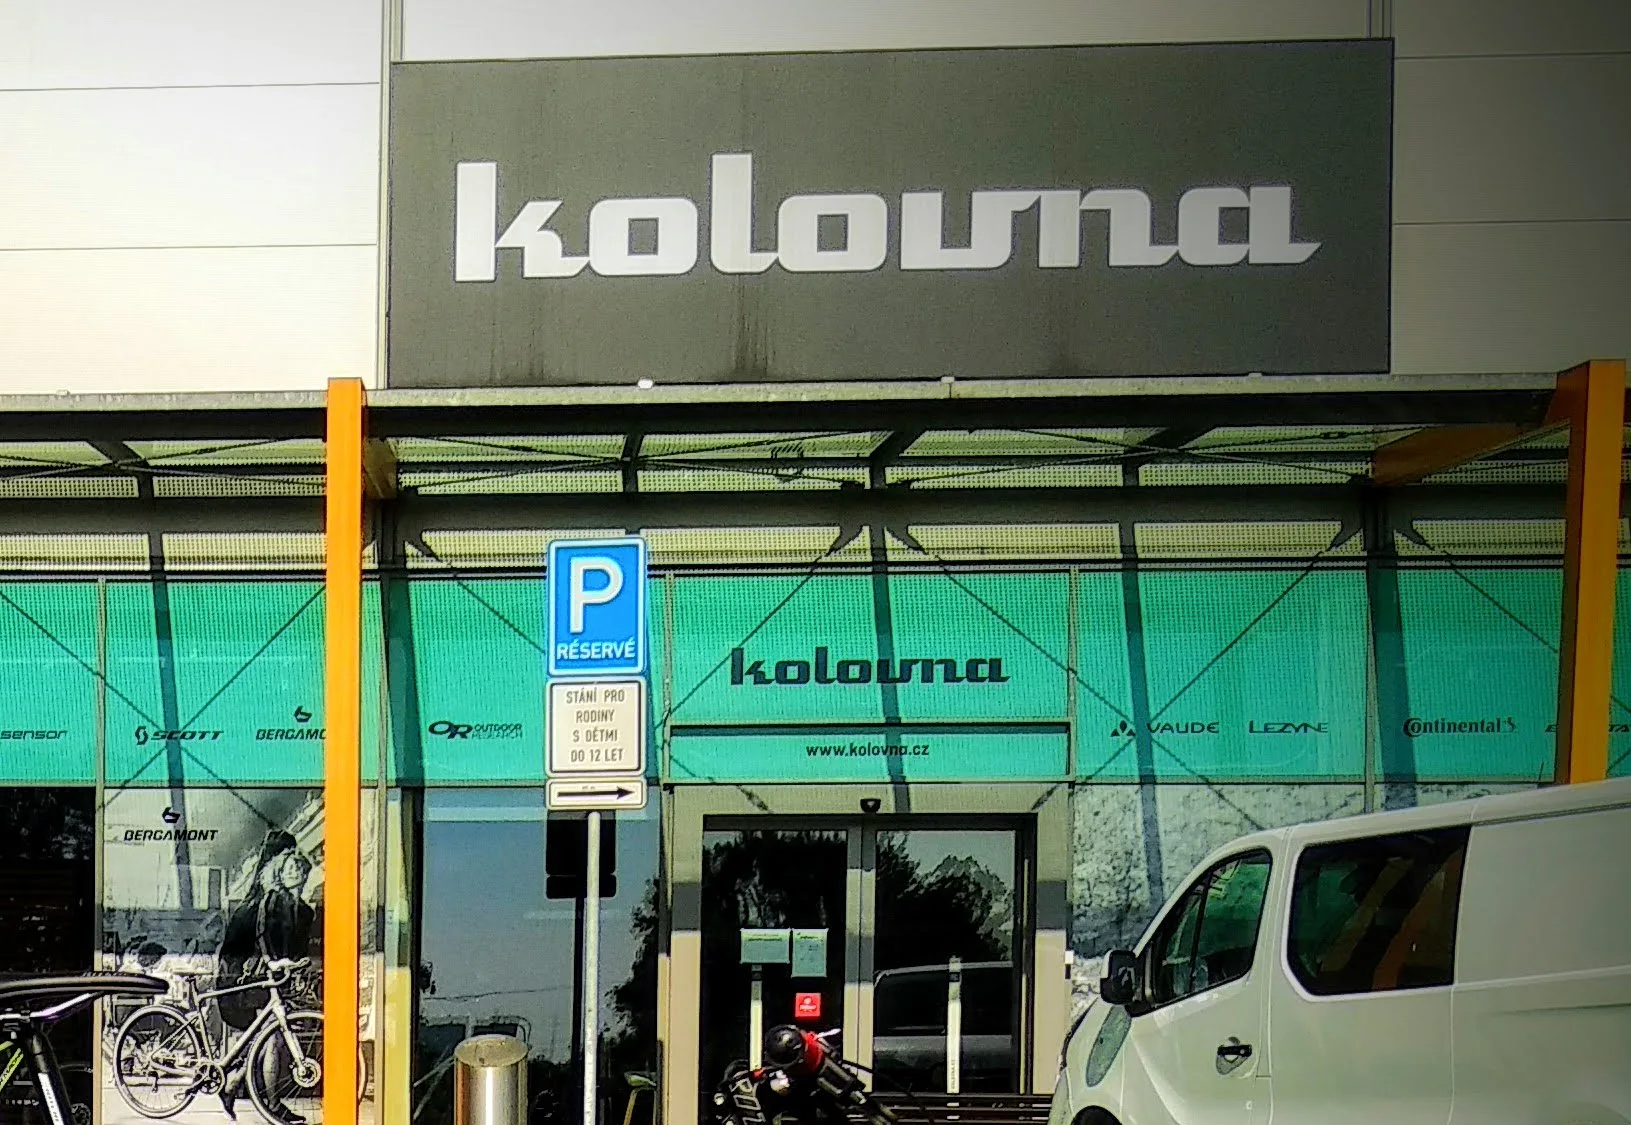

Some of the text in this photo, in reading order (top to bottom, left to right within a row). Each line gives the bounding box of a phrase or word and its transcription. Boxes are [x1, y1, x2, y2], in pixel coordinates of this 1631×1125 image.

[454, 150, 1323, 283] kolovna
[570, 556, 624, 634] P
[556, 636, 636, 660] RÉSERVÉ
[730, 646, 1011, 685] kolovna
[566, 687, 625, 704] STÁNÍ PRO
[576, 710, 616, 723] RODINY
[1147, 721, 1220, 734] VAUDE
[1249, 720, 1329, 734] LEZYNE
[1403, 717, 1501, 738] Continental
[0, 730, 69, 740] sensor
[151, 730, 224, 740] SCOTT
[256, 729, 326, 740] BERGAMO
[573, 729, 580, 742] S
[571, 748, 624, 762] DO 12 LET
[806, 743, 930, 757] www.kolovna.cz
[124, 829, 219, 841] BERGAMONT
